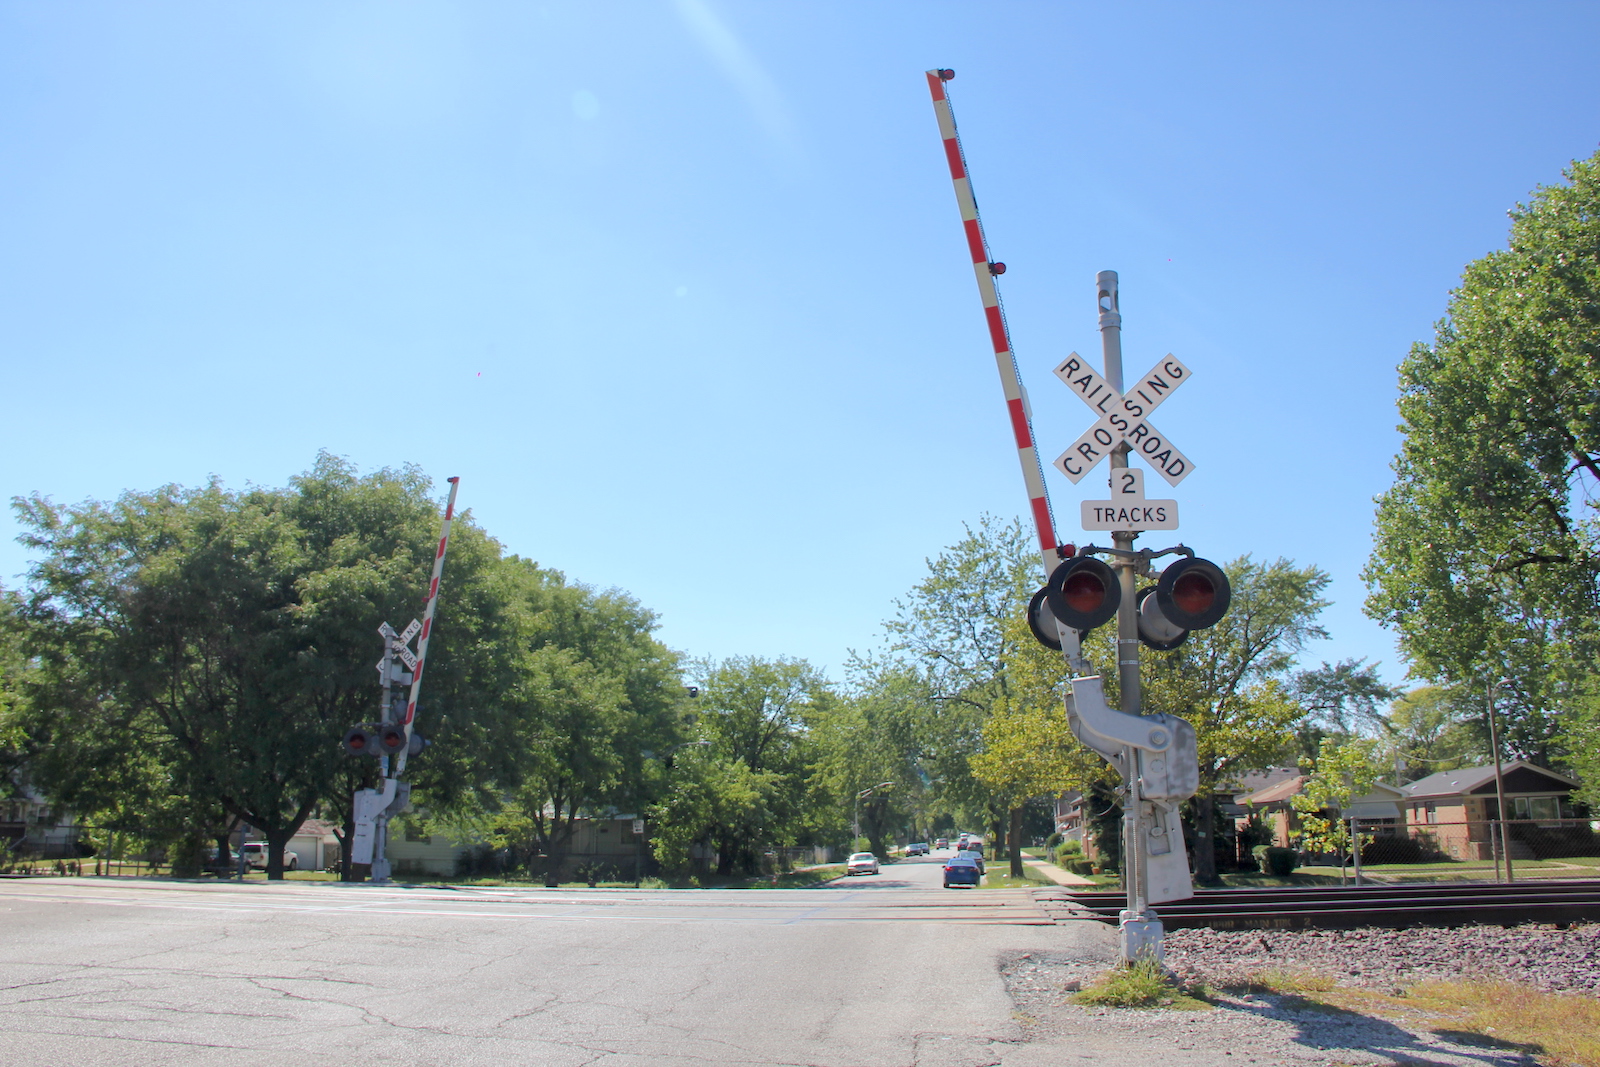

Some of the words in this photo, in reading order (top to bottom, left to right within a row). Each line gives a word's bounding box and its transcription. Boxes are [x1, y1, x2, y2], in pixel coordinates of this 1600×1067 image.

[1063, 361, 1183, 476] CROSSING
[1121, 474, 1136, 494] 2
[1094, 507, 1166, 523] TRACKS
[1304, 917, 1312, 926] 2
